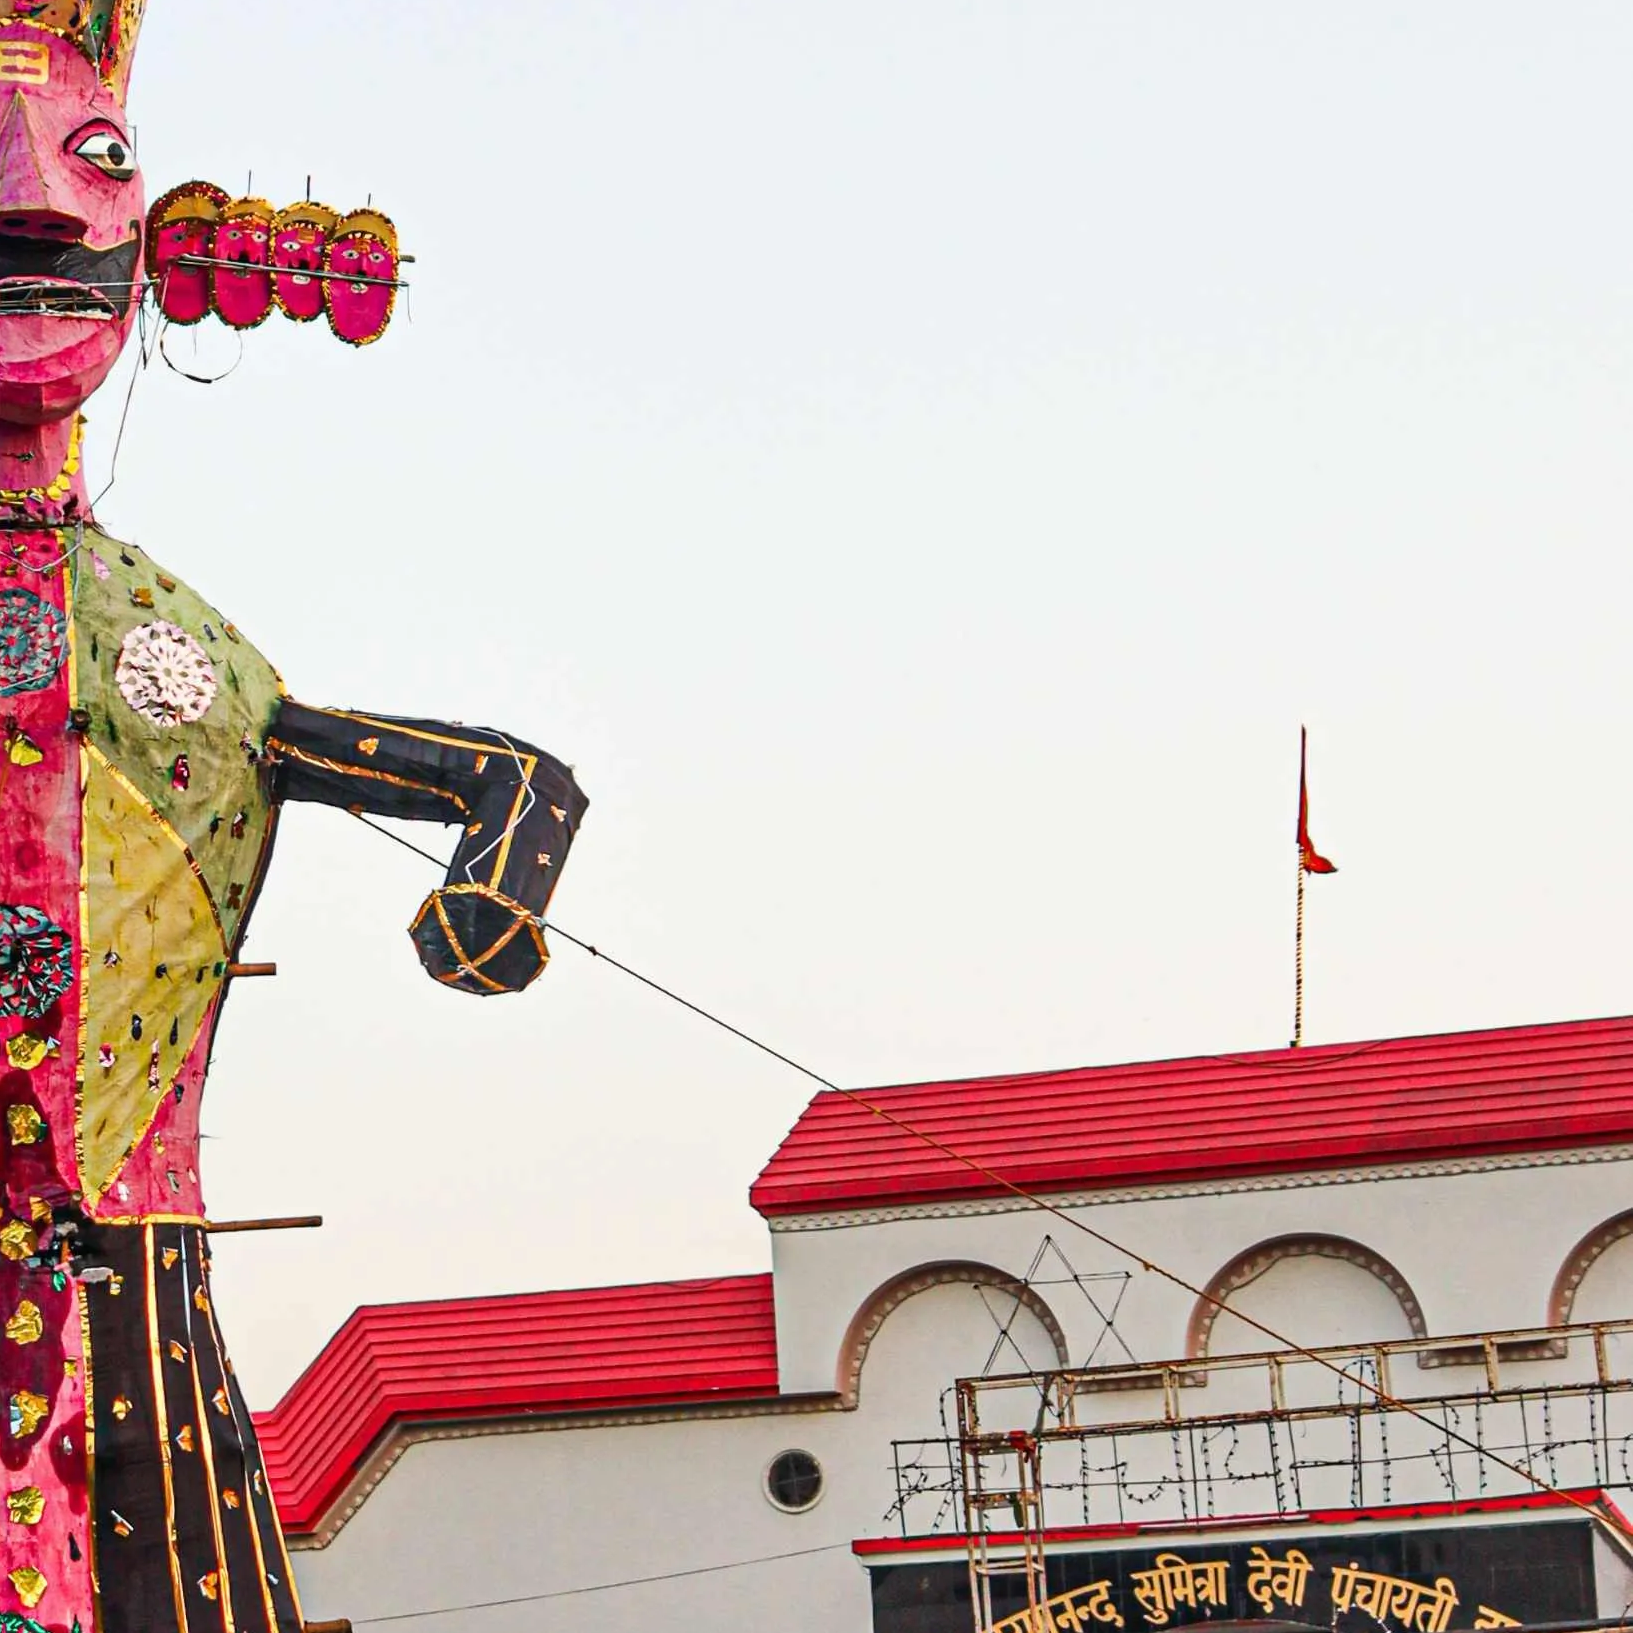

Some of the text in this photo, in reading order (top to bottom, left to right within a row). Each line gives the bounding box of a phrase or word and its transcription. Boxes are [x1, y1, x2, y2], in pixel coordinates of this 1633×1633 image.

[1130, 1553, 1230, 1625] सुमित्रा
[1247, 1546, 1314, 1614] देवी
[1331, 1561, 1460, 1633] पंचायती
